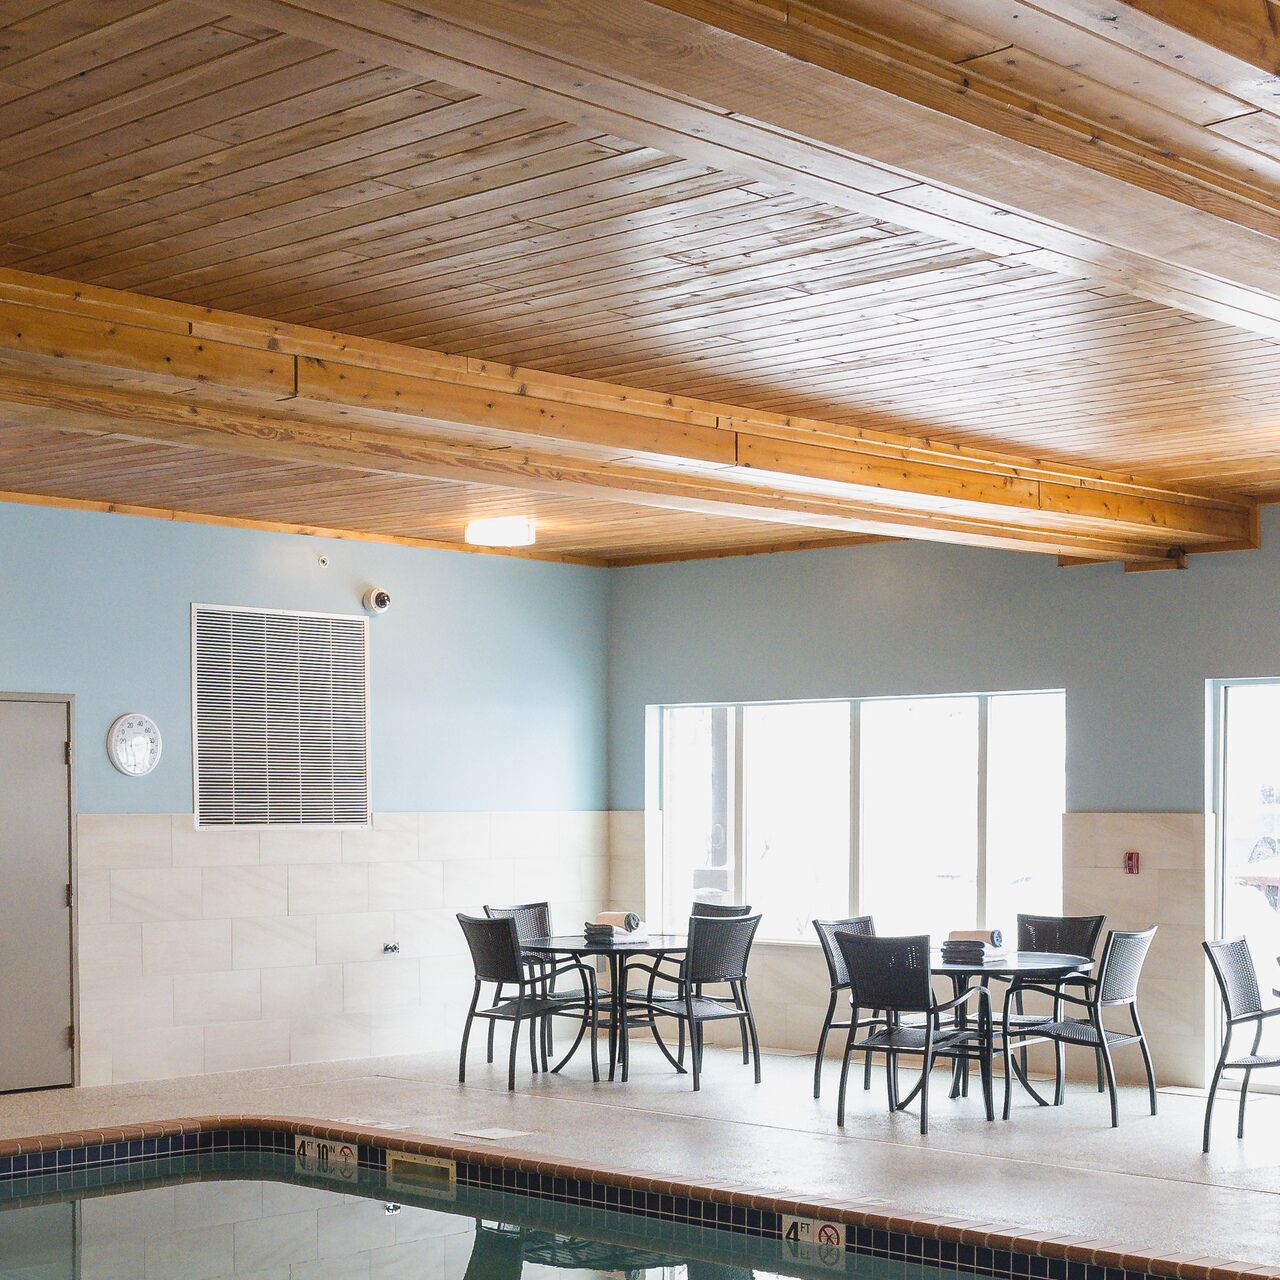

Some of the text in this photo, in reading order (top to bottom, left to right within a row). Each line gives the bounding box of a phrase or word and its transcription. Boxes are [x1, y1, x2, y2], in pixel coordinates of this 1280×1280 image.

[297, 1139, 336, 1160] 4 FT 10 IN
[785, 1221, 811, 1242] 4 FT
